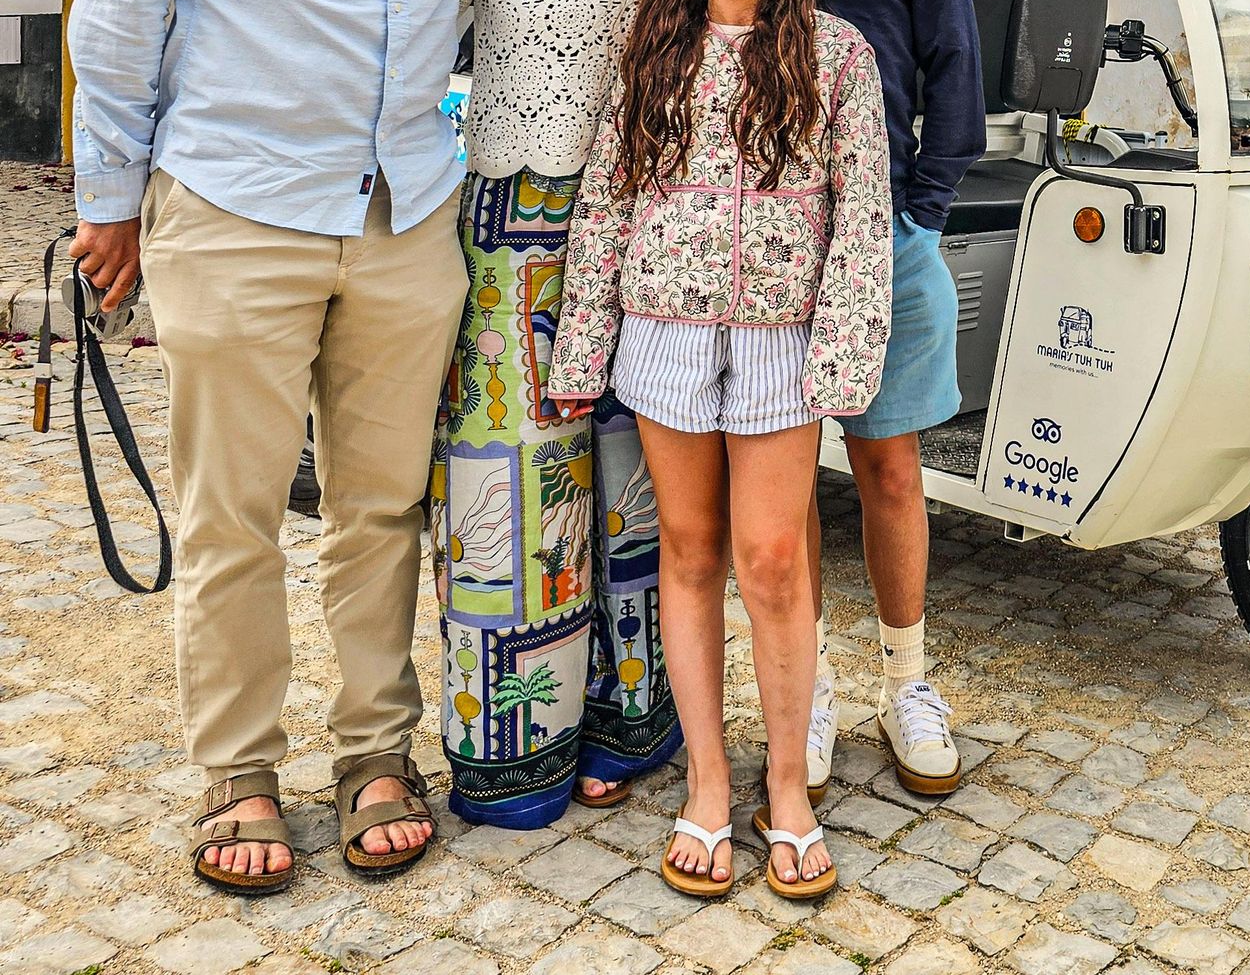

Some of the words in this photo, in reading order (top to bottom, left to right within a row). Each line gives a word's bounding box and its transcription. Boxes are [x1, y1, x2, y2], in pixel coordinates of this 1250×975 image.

[1037, 344, 1073, 361] MARIA'S
[1075, 353, 1092, 367] TUK
[1095, 358, 1113, 372] TUK
[1049, 362, 1075, 372] memories
[1005, 440, 1079, 484] Google
